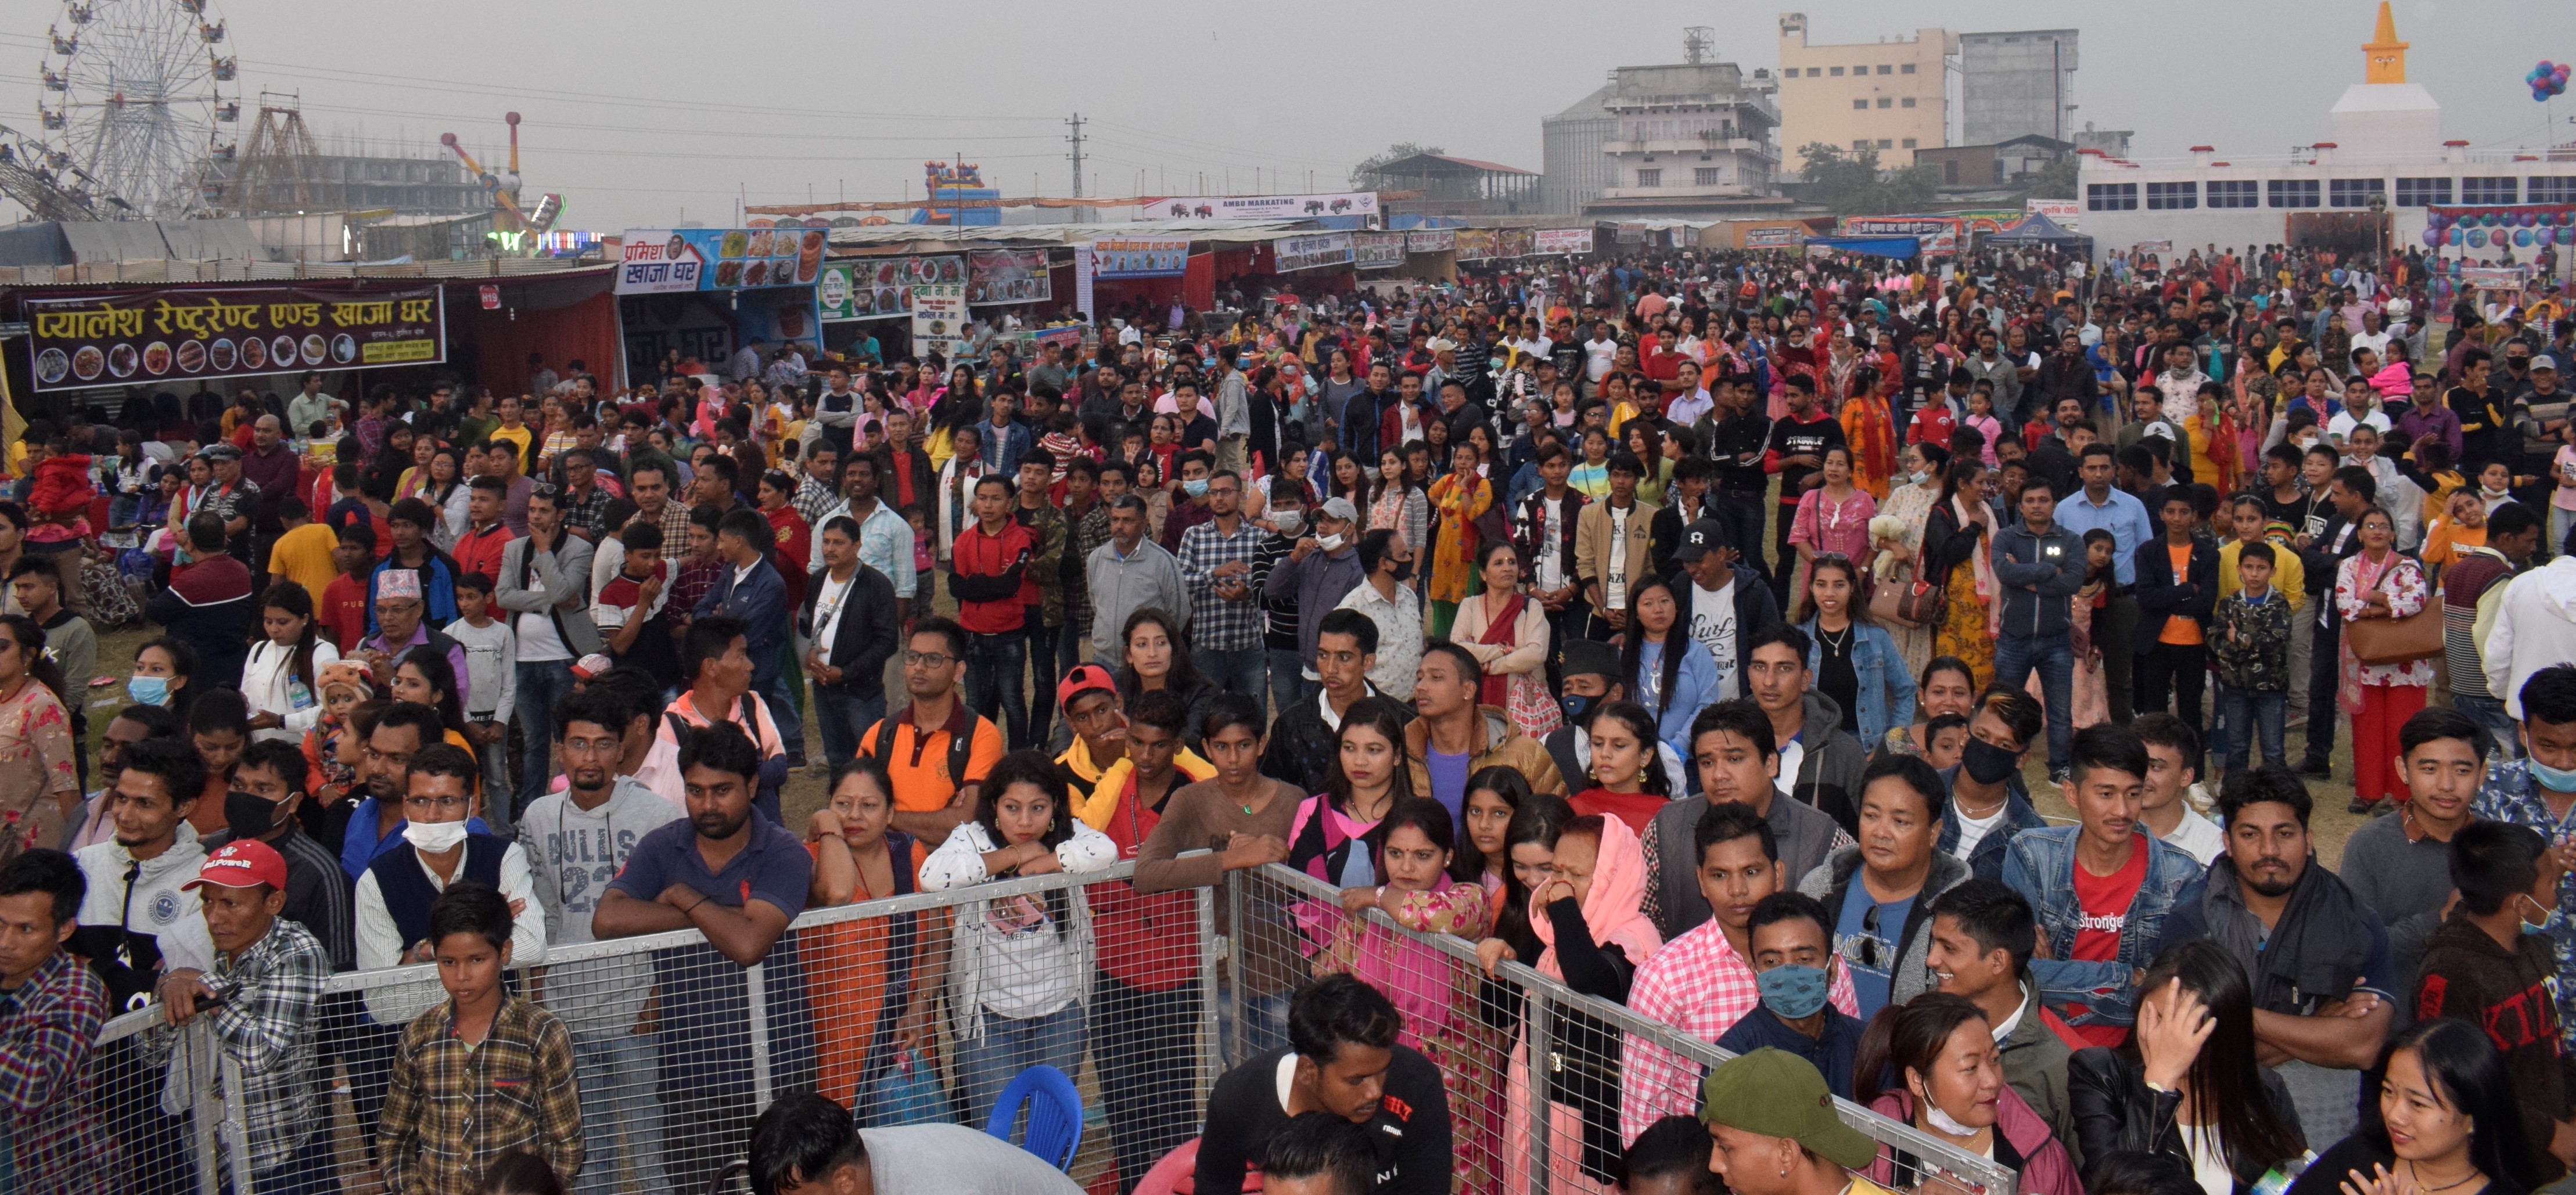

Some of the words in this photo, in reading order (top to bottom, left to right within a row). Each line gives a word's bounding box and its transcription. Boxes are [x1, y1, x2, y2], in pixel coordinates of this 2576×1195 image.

[1248, 199, 1294, 207] MARKATING
[622, 241, 665, 264] प्रमिश
[626, 263, 671, 283] खाजा
[674, 262, 697, 281] घर
[912, 285, 932, 299] दुना
[36, 302, 145, 338] प्यालेश
[154, 297, 261, 339] रेष्टुरेण्ट
[268, 303, 322, 329] एण्ड
[330, 301, 394, 327] खाजा
[400, 299, 434, 323] घर
[1691, 614, 1733, 639] Surf
[548, 829, 634, 866] BULLS
[2482, 982, 2553, 1050] KTZ
